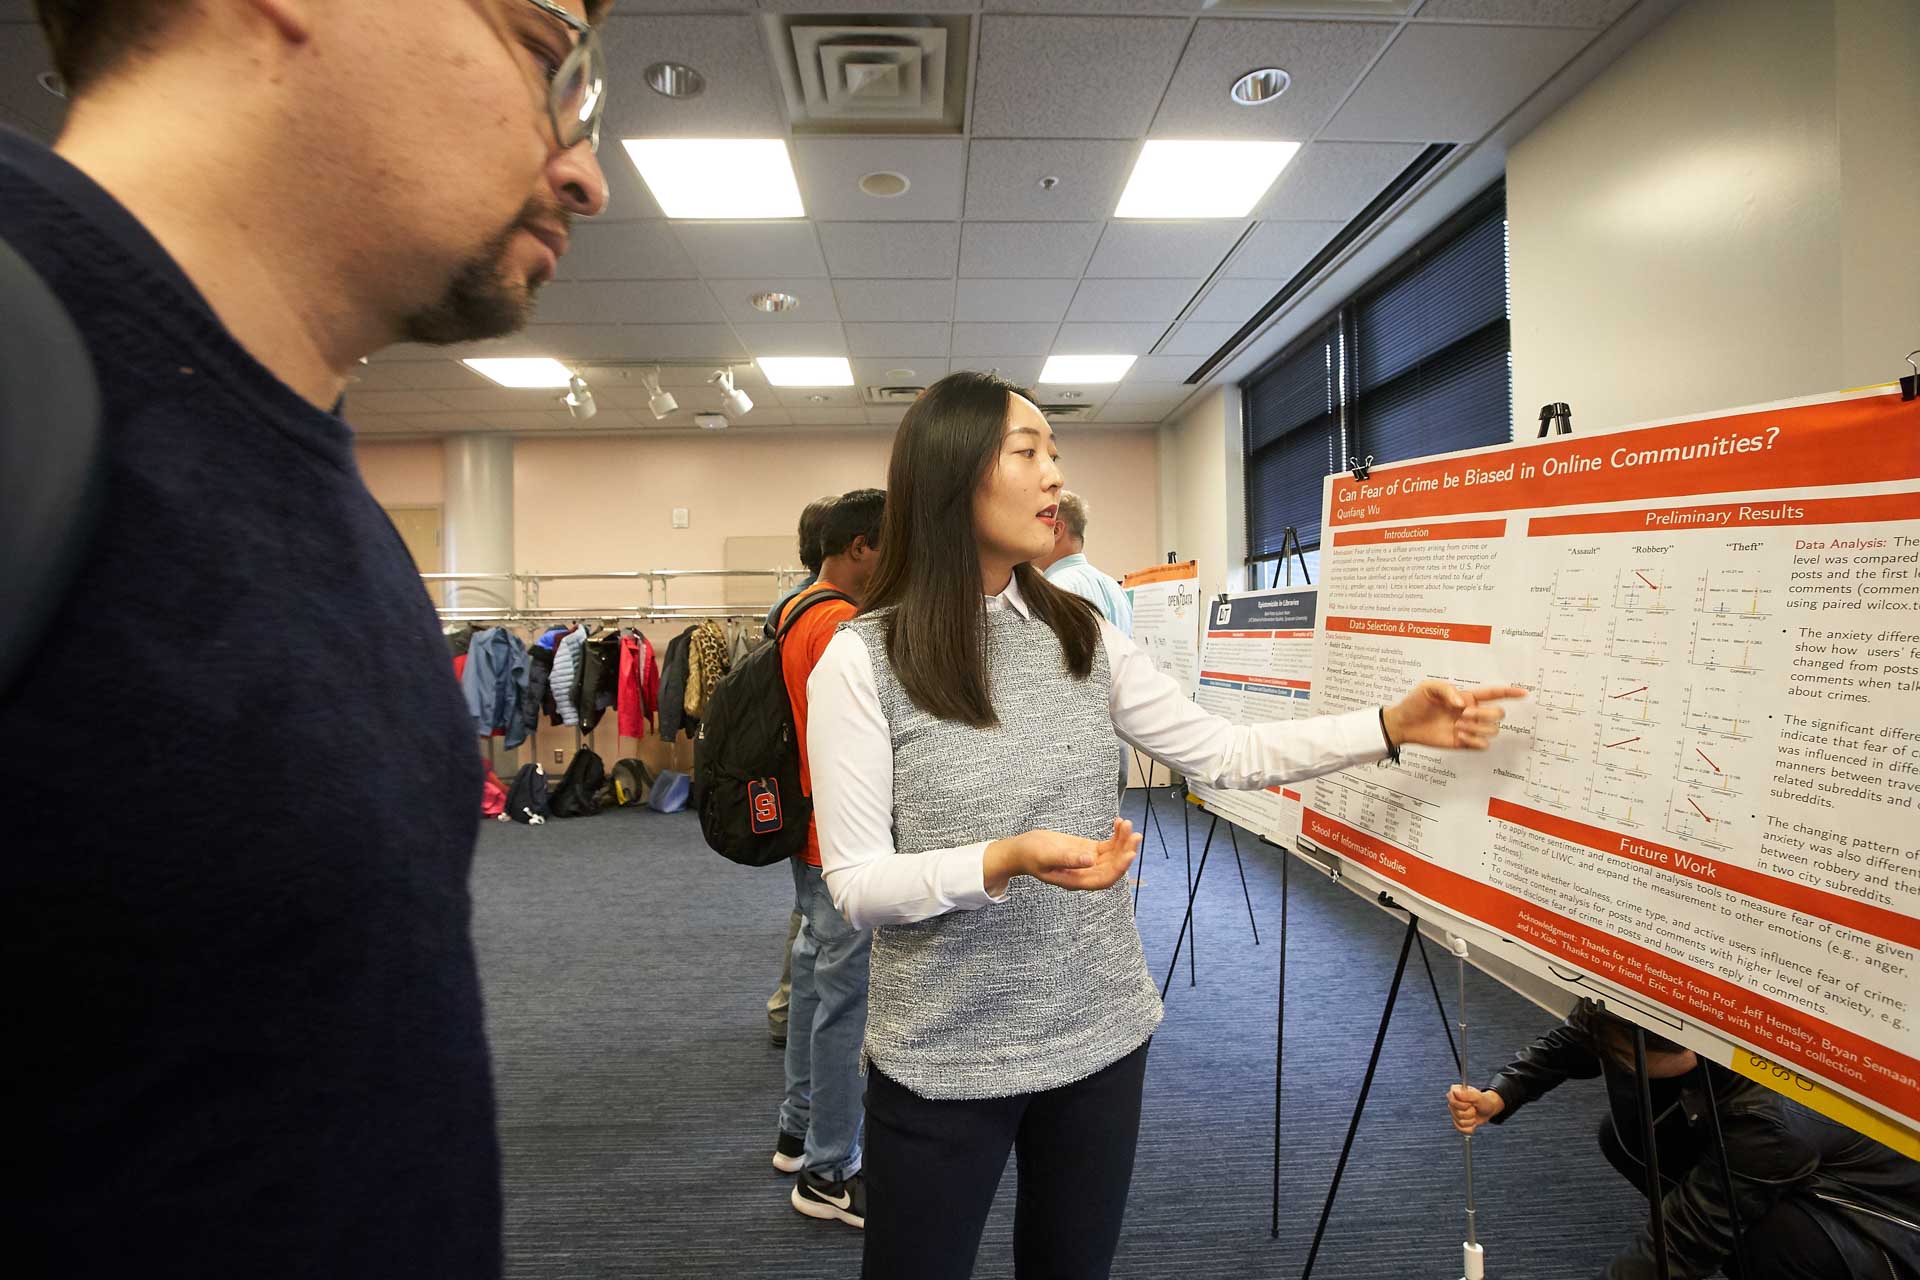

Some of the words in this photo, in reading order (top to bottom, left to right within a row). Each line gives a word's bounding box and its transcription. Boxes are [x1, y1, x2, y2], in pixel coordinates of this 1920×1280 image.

[1339, 489, 1356, 502] Can
[1361, 485, 1382, 499] Fear
[1386, 480, 1398, 494] of
[1402, 478, 1438, 492] Crime
[1443, 474, 1459, 487] be
[1464, 465, 1513, 486] Biased
[1520, 464, 1534, 478] in
[1542, 455, 1601, 477] Online
[1610, 427, 1780, 468] Communities?
[1337, 507, 1365, 520] Qunfang
[1368, 506, 1380, 515] Wu
[1645, 511, 1731, 525] Preliminary
[1738, 504, 1804, 520] Results
[1384, 528, 1428, 539] Introduction
[1796, 540, 1825, 550] Data
[1830, 538, 1887, 550] Analysis:
[1894, 536, 1920, 546] The
[1456, 553, 1488, 561] perception
[1794, 555, 1820, 564] level
[1825, 556, 1848, 564] was
[1854, 552, 1918, 565] compared
[1791, 570, 1822, 580] posts
[1827, 569, 1850, 579] and
[1856, 569, 1876, 579] the
[1882, 568, 1908, 579] first
[1168, 595, 1179, 606] OPEN
[1182, 594, 1192, 606] DATA
[1789, 585, 1852, 594] comments
[1786, 599, 1818, 610] using
[1822, 600, 1861, 610] paired
[1350, 619, 1365, 630] Data
[1366, 621, 1396, 633] Selection
[1407, 623, 1449, 638] Processing
[1799, 628, 1822, 638] The
[1827, 630, 1872, 643] anxiety
[1795, 643, 1827, 653] show
[1832, 644, 1858, 655] how
[1793, 657, 1844, 670] changed
[1850, 660, 1878, 672] from
[1883, 664, 1919, 675] posts
[1790, 674, 1854, 686] comments
[1858, 678, 1891, 689] when
[1788, 687, 1822, 698] about
[1827, 691, 1871, 703] crimes.
[1784, 714, 1807, 726] The
[1812, 718, 1875, 736] significant
[1780, 729, 1828, 744] indicate
[1833, 737, 1858, 750] that
[1863, 740, 1888, 753] fear
[1892, 745, 1908, 756] of
[1778, 745, 1800, 756] was
[1805, 748, 1868, 766] influenced
[1872, 758, 1884, 769] in
[1776, 760, 1826, 775] manners
[1831, 767, 1882, 785] between
[1770, 788, 1834, 808] subreddits.
[1773, 774, 1814, 789] related
[1818, 783, 1882, 802] subreddits
[1886, 796, 1912, 808] and
[1763, 832, 1805, 850] anxiety
[1810, 843, 1832, 856] was
[1837, 850, 1862, 863] also
[1768, 816, 1789, 830] The
[1793, 823, 1848, 846] changing
[1852, 838, 1900, 856] pattern
[1311, 821, 1331, 838] School
[1341, 834, 1377, 861] Information
[1379, 852, 1407, 876] Studies
[1620, 838, 1668, 864] Future
[1674, 853, 1717, 878] Work
[1760, 844, 1808, 865] between
[1814, 859, 1860, 880] robbery
[1864, 874, 1888, 887] and
[1757, 858, 1768, 870] in
[1772, 864, 1794, 877] two
[1798, 872, 1821, 886] city
[1826, 879, 1894, 906] subreddits.
[1548, 836, 1584, 856] sentiment
[1588, 849, 1604, 862] and
[1607, 856, 1652, 877] emotional
[1656, 868, 1693, 890] analysis
[1697, 882, 1722, 898] tools
[1725, 890, 1736, 903] to
[1740, 898, 1786, 920] measure
[1792, 911, 1814, 928] fear
[1836, 928, 1871, 948] crime
[1875, 940, 1914, 962] given
[1597, 867, 1630, 885] expand
[1632, 876, 1648, 888] the
[1651, 884, 1716, 912] measurement
[1735, 910, 1764, 927] other
[1768, 922, 1822, 948] emotions
[1504, 857, 1540, 877] investigate
[1616, 898, 1643, 914] crime
[1672, 917, 1690, 931] and
[1694, 926, 1725, 944] active
[1728, 938, 1756, 955] users
[1760, 948, 1812, 976] influence
[1817, 968, 1840, 986] fear
[1559, 890, 1590, 910] analysis
[1608, 908, 1632, 924] posts
[1636, 918, 1652, 931] and
[1656, 926, 1706, 951] comments
[1710, 946, 1734, 962] with
[1737, 955, 1772, 976] higher
[1776, 970, 1803, 988] level
[1578, 911, 1604, 926] crime
[1618, 926, 1642, 942] posts
[1644, 934, 1662, 949] and
[1664, 942, 1685, 957] how
[1688, 950, 1714, 970] users
[1718, 963, 1744, 983] reply
[1762, 983, 1828, 1016] comments.
[1518, 911, 1578, 943] Acknowledgment:
[1580, 937, 1610, 956] Thanks
[1644, 963, 1684, 987] feedback
[1688, 981, 1709, 998] from
[1713, 992, 1738, 1010] Prof.
[1742, 1004, 1762, 1020] Jeff
[1822, 1038, 1858, 1063] Bryan
[1562, 940, 1589, 959] Thanks
[1688, 996, 1724, 1020] helping
[1728, 1013, 1750, 1030] with
[1755, 1025, 1773, 1040] the
[1776, 1035, 1802, 1052] data
[1806, 1048, 1866, 1082] collection.
